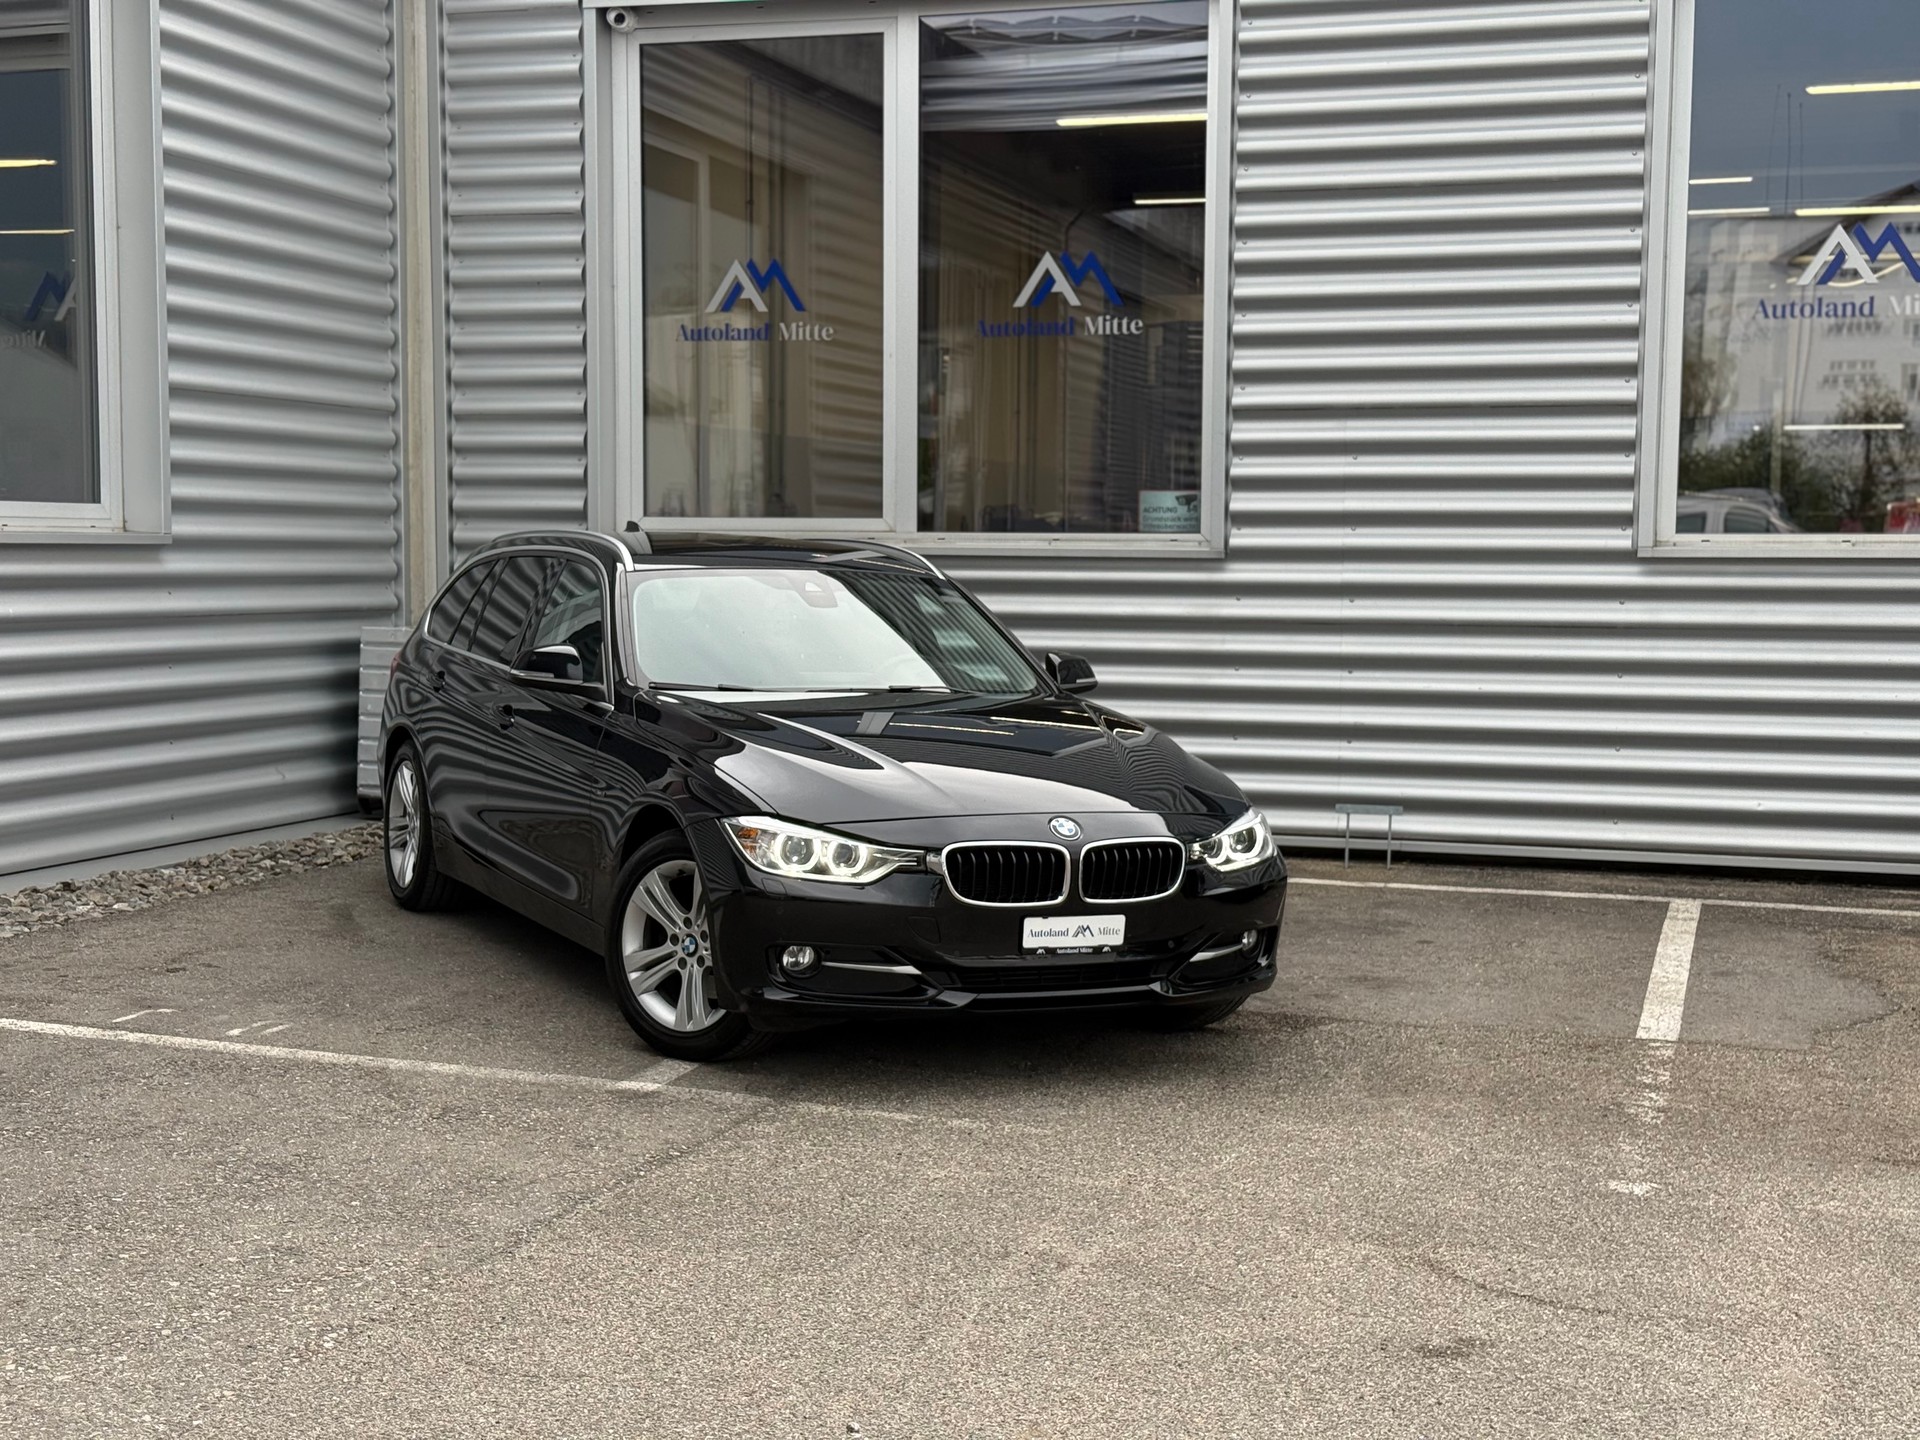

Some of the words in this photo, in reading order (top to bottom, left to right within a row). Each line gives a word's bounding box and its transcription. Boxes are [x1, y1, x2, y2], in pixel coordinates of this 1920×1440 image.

[1752, 295, 1875, 320] Autoland
[676, 322, 771, 342] Autoland
[779, 321, 834, 341] Mitte
[977, 316, 1076, 338] Autoland
[1084, 315, 1144, 336] Mitte
[1028, 927, 1070, 938] Autoland
[1098, 926, 1121, 936] Mitte
